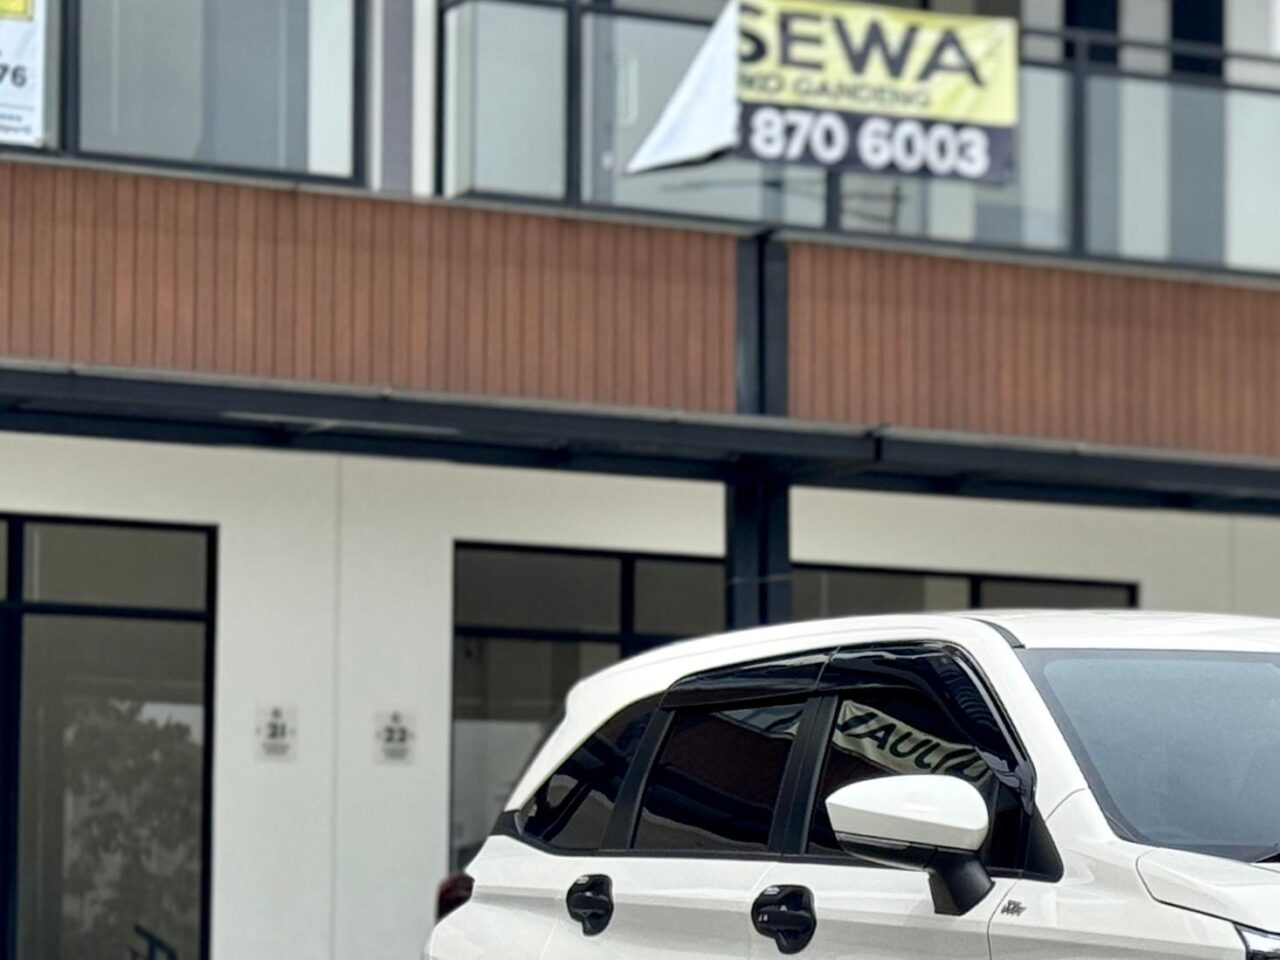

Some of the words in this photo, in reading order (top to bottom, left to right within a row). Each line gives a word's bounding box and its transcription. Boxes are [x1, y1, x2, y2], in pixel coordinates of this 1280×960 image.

[738, 4, 986, 87] SEWA
[750, 109, 848, 163] 870
[857, 126, 990, 179] 6003
